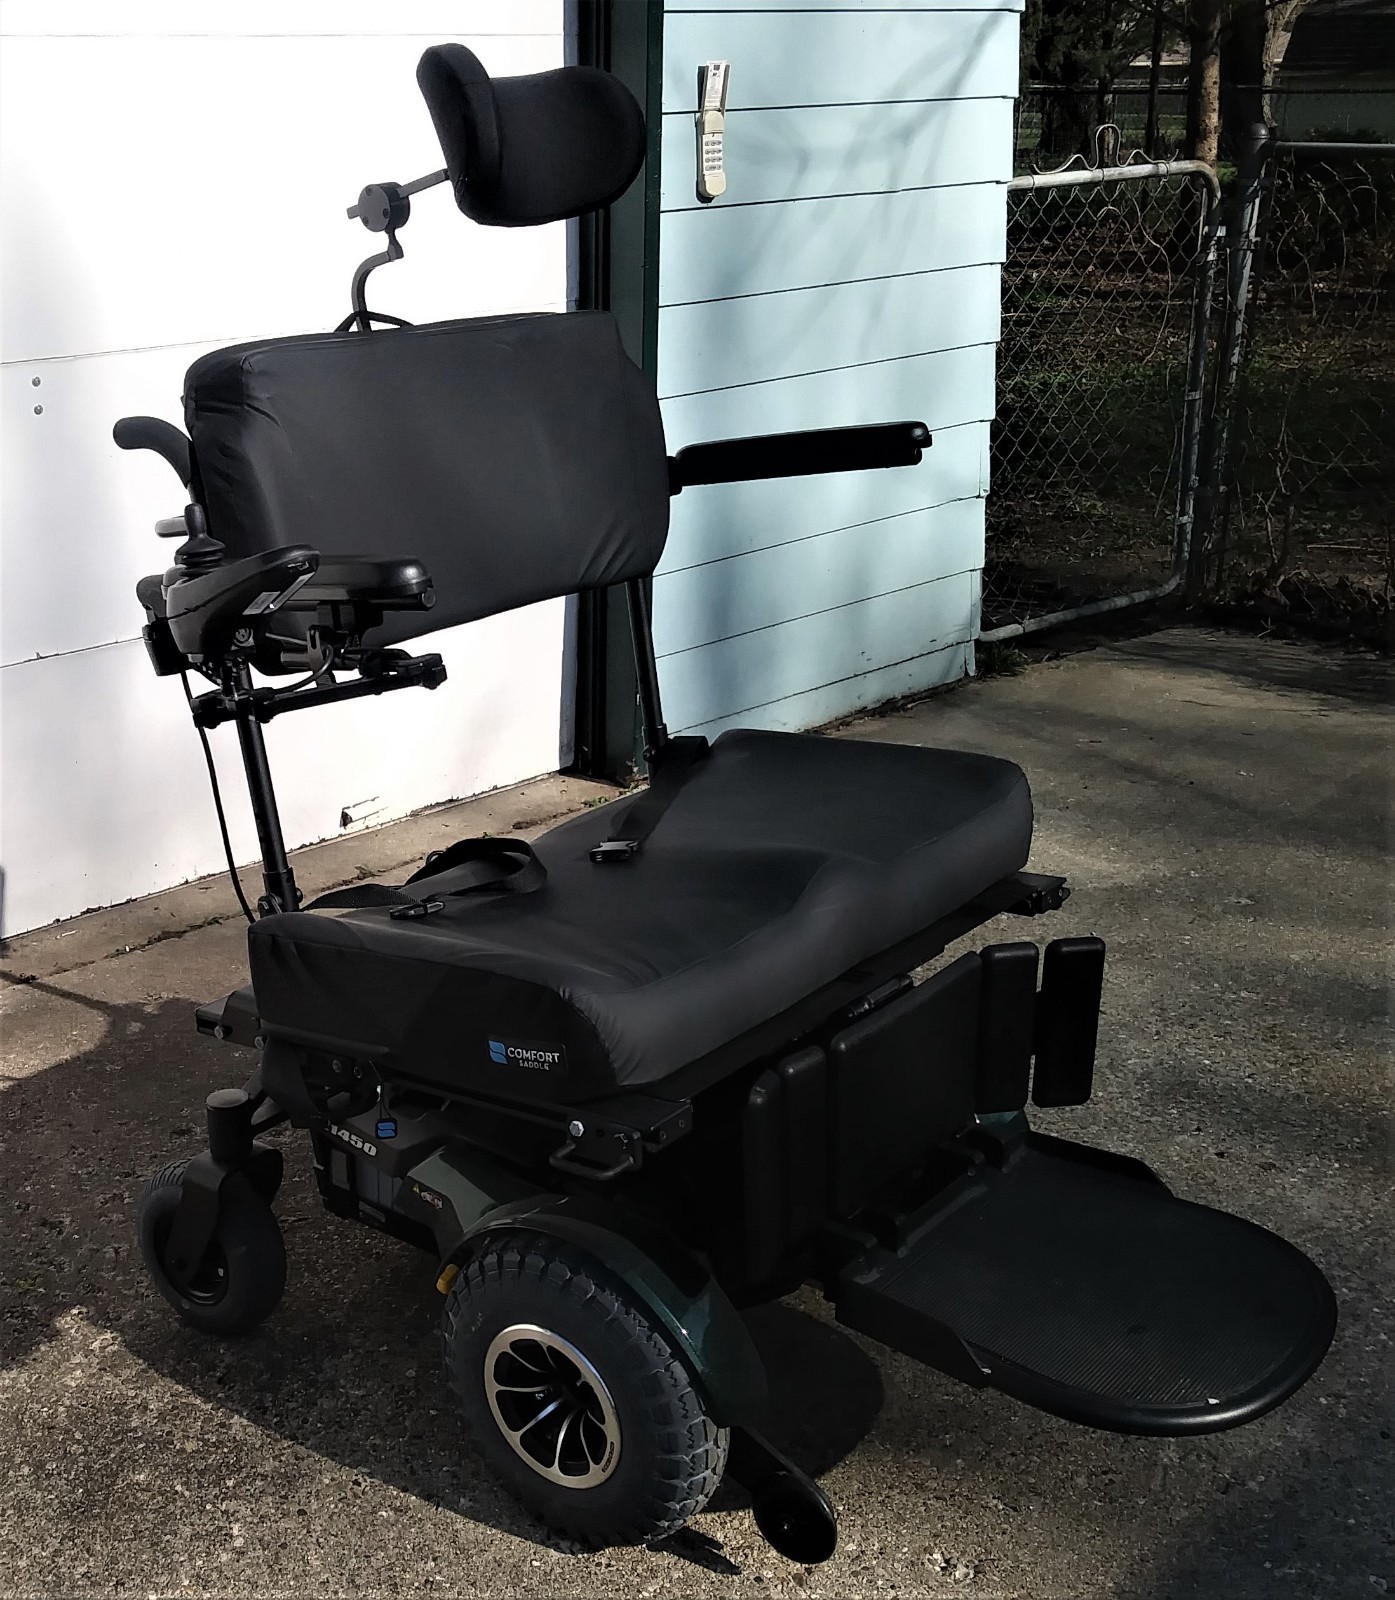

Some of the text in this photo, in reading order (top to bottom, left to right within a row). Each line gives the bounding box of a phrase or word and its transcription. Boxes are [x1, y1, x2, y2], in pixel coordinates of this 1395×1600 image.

[507, 1047, 560, 1063] COMFORT
[519, 1060, 549, 1071] SADDLE
[330, 1123, 378, 1157] 1450
